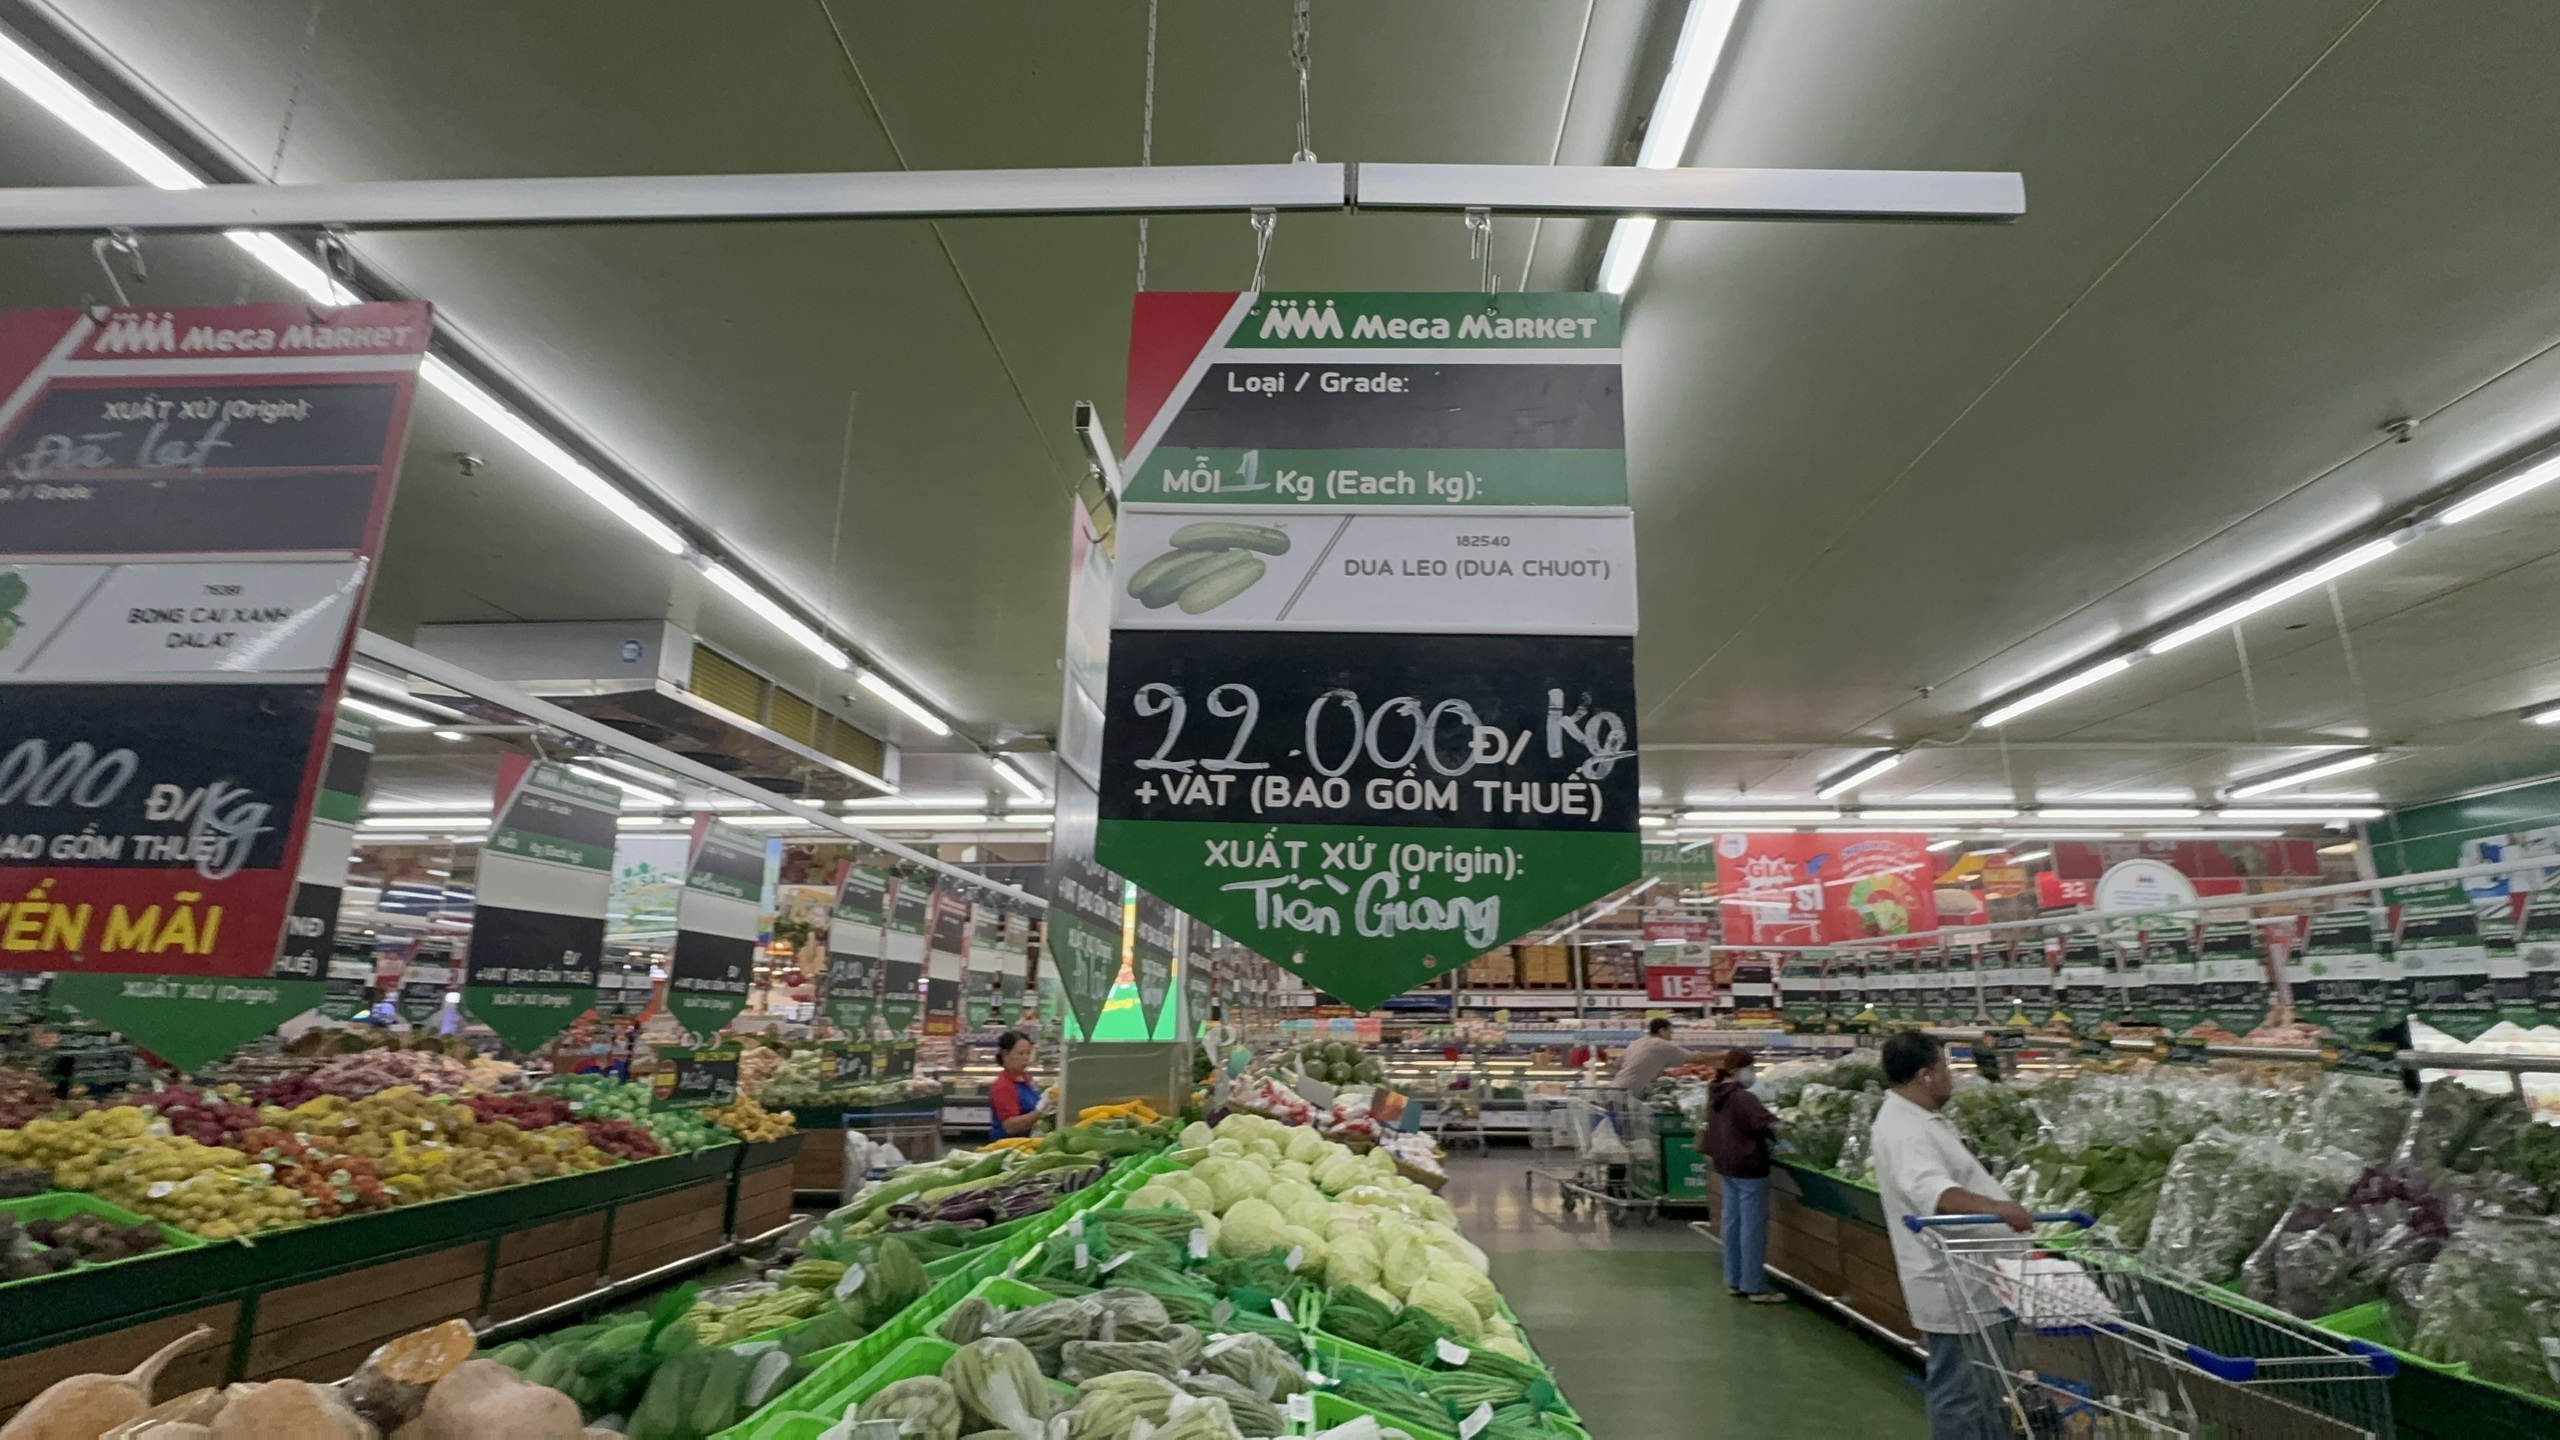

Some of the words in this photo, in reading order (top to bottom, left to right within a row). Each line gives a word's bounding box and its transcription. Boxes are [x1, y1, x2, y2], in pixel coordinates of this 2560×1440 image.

[1228, 371, 1285, 397] Loại
[1294, 371, 1310, 392] /
[1320, 371, 1409, 394] Grade:
[1162, 456, 1222, 493] MỖI
[1275, 470, 1315, 499] Kg
[1326, 469, 1420, 498] (Each
[1427, 469, 1484, 502] kg):
[1456, 535, 1511, 548] 182540
[1344, 559, 1395, 577] DUA
[1402, 559, 1448, 577] LEO
[1456, 558, 1514, 581] (DUA
[1521, 558, 1612, 580] CHUOT)
[1133, 682, 1480, 778] 22.000
[1134, 773, 1237, 806] +VAT
[1251, 774, 1351, 814] (BAO
[1365, 762, 1458, 812] GỒM
[1204, 827, 1308, 869] XUẤT
[1320, 834, 1378, 872] XỨ
[1389, 843, 1524, 883] (Origin):
[2058, 881, 2088, 899] 32
[101, 891, 223, 954] MÃI
